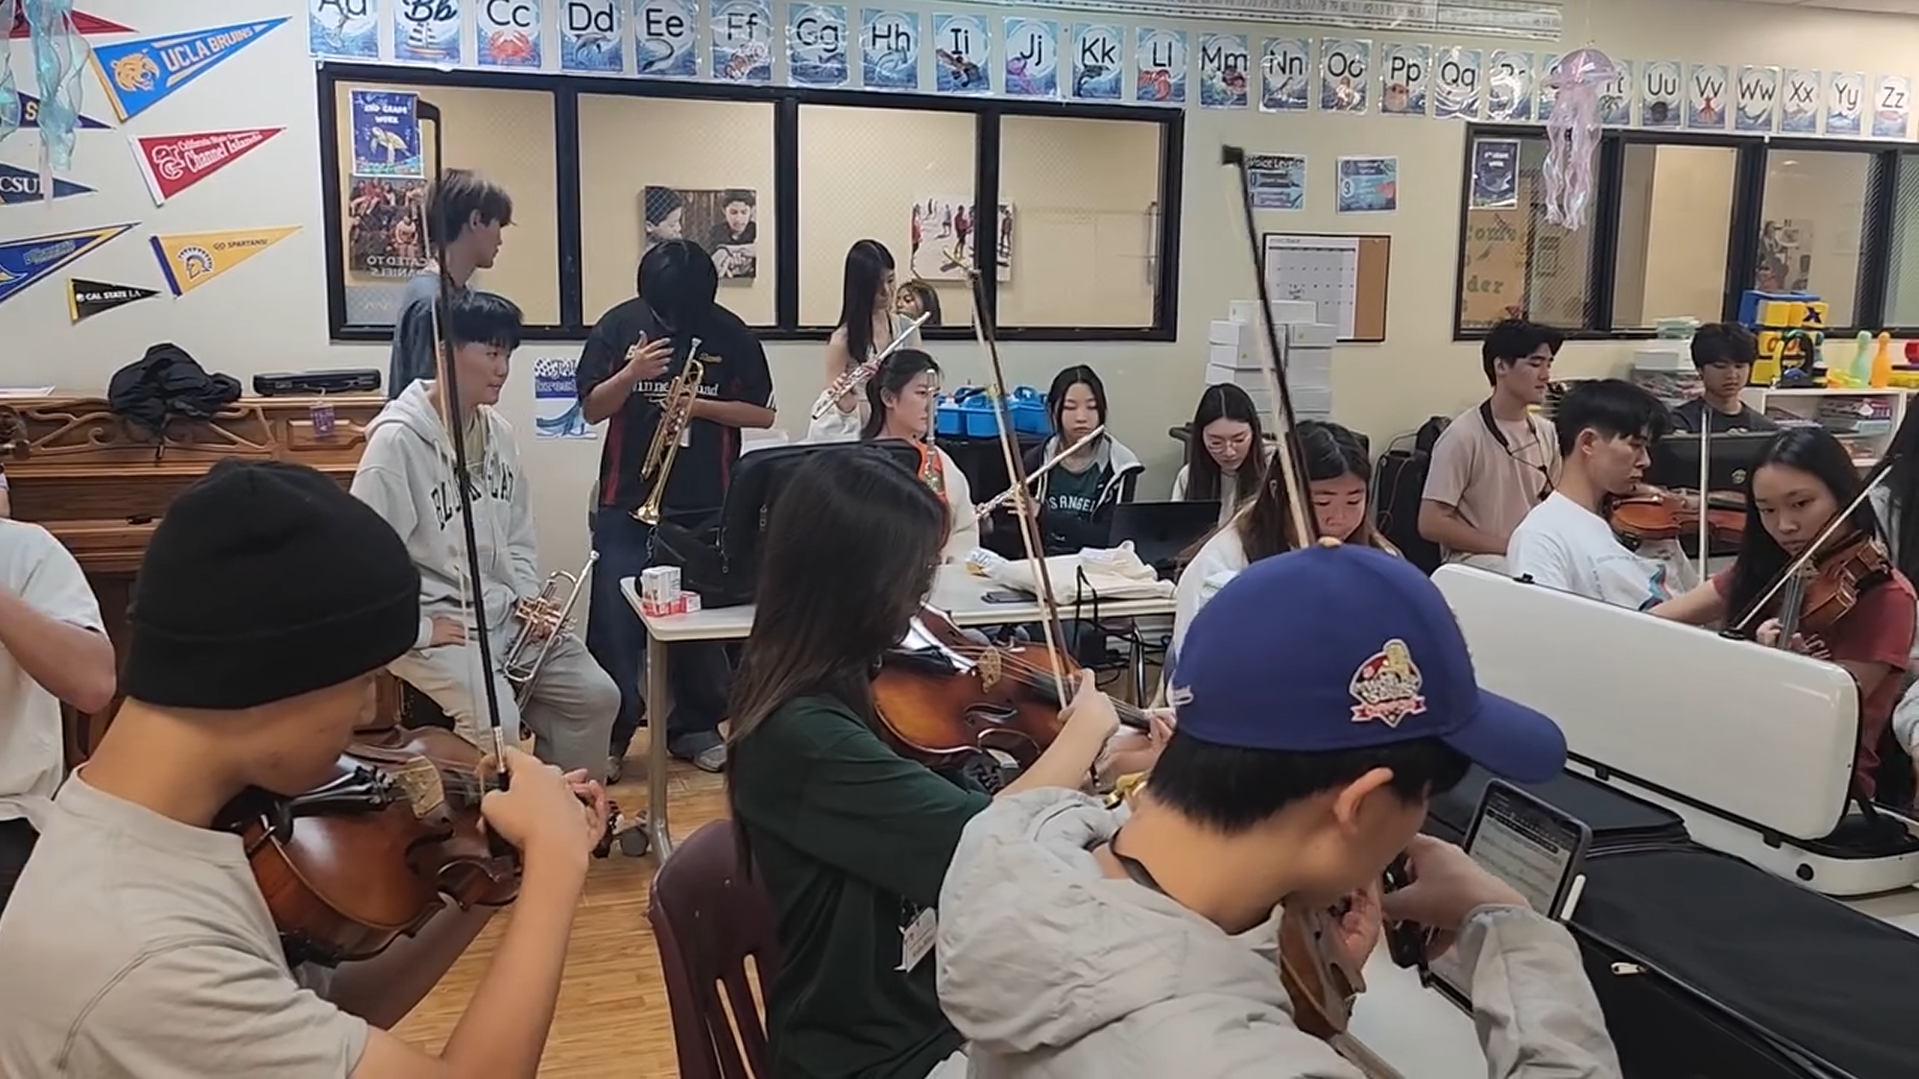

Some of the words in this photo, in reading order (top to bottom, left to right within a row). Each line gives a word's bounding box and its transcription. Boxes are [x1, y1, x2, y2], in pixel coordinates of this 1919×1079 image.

[486, 0, 531, 28] Cc
[568, 2, 614, 33] Dd
[646, 9, 684, 37] Ee
[726, 12, 758, 41] Ff
[796, 17, 839, 53] Gg
[870, 24, 911, 53] Hh
[949, 27, 969, 55] Ii
[160, 38, 210, 72] UCLA
[207, 27, 253, 52] BRUINS
[1020, 33, 1044, 67] Jj
[1081, 36, 1116, 65] Kk
[1153, 41, 1173, 68] Ll
[1200, 45, 1248, 72] Mm
[1269, 50, 1304, 76] Nn
[1327, 52, 1364, 79] Oo
[1390, 56, 1421, 87] Pp
[1440, 61, 1476, 92] Qq
[1647, 73, 1677, 96] Uu
[1695, 76, 1723, 97] Vv
[1739, 79, 1776, 102] Ww
[1790, 80, 1815, 104] Xx
[1834, 83, 1858, 110] Yy
[1881, 86, 1904, 109] Zz
[185, 142, 228, 172] Channel
[213, 242, 226, 251] GO
[85, 292, 102, 301] CAL
[103, 290, 127, 300] STATE
